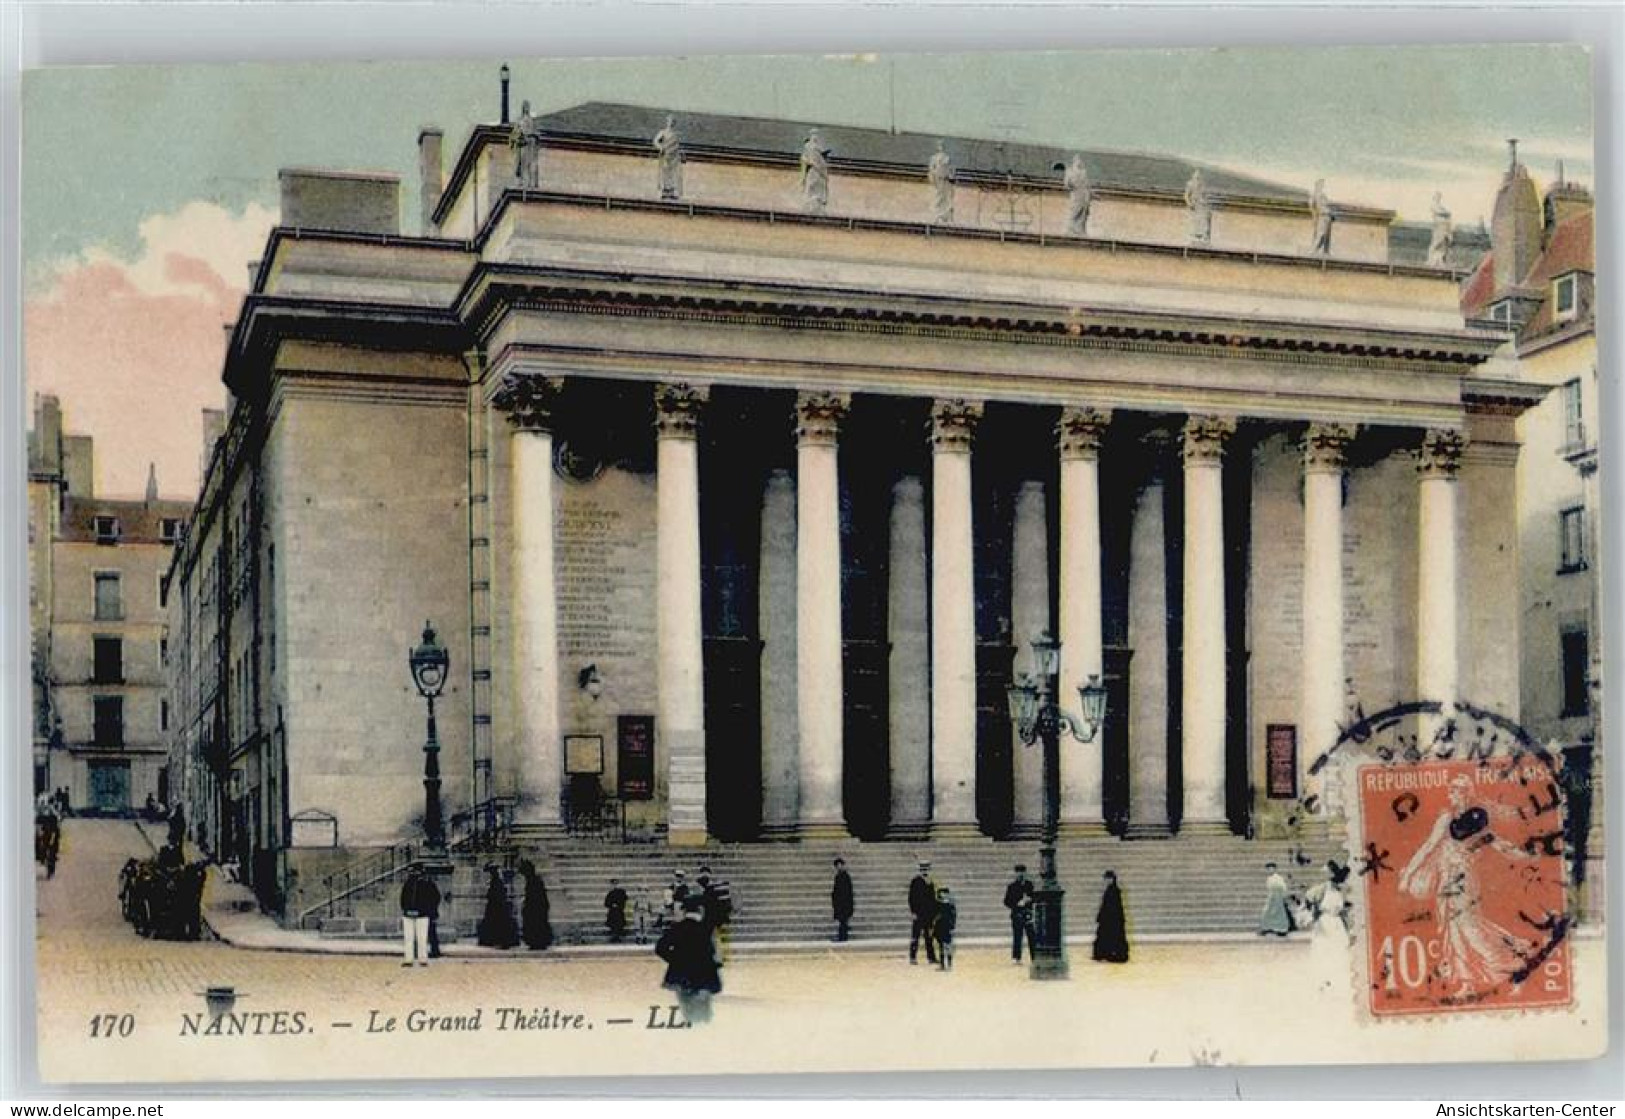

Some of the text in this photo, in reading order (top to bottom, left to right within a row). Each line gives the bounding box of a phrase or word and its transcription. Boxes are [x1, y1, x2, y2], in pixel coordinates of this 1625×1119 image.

[90, 1013, 136, 1038] 170
[180, 1010, 315, 1037] NANTES.
[367, 1009, 397, 1034] Le
[406, 1008, 483, 1033] Grand
[496, 1007, 594, 1032] Théâtre.
[646, 1005, 692, 1030] LL.
